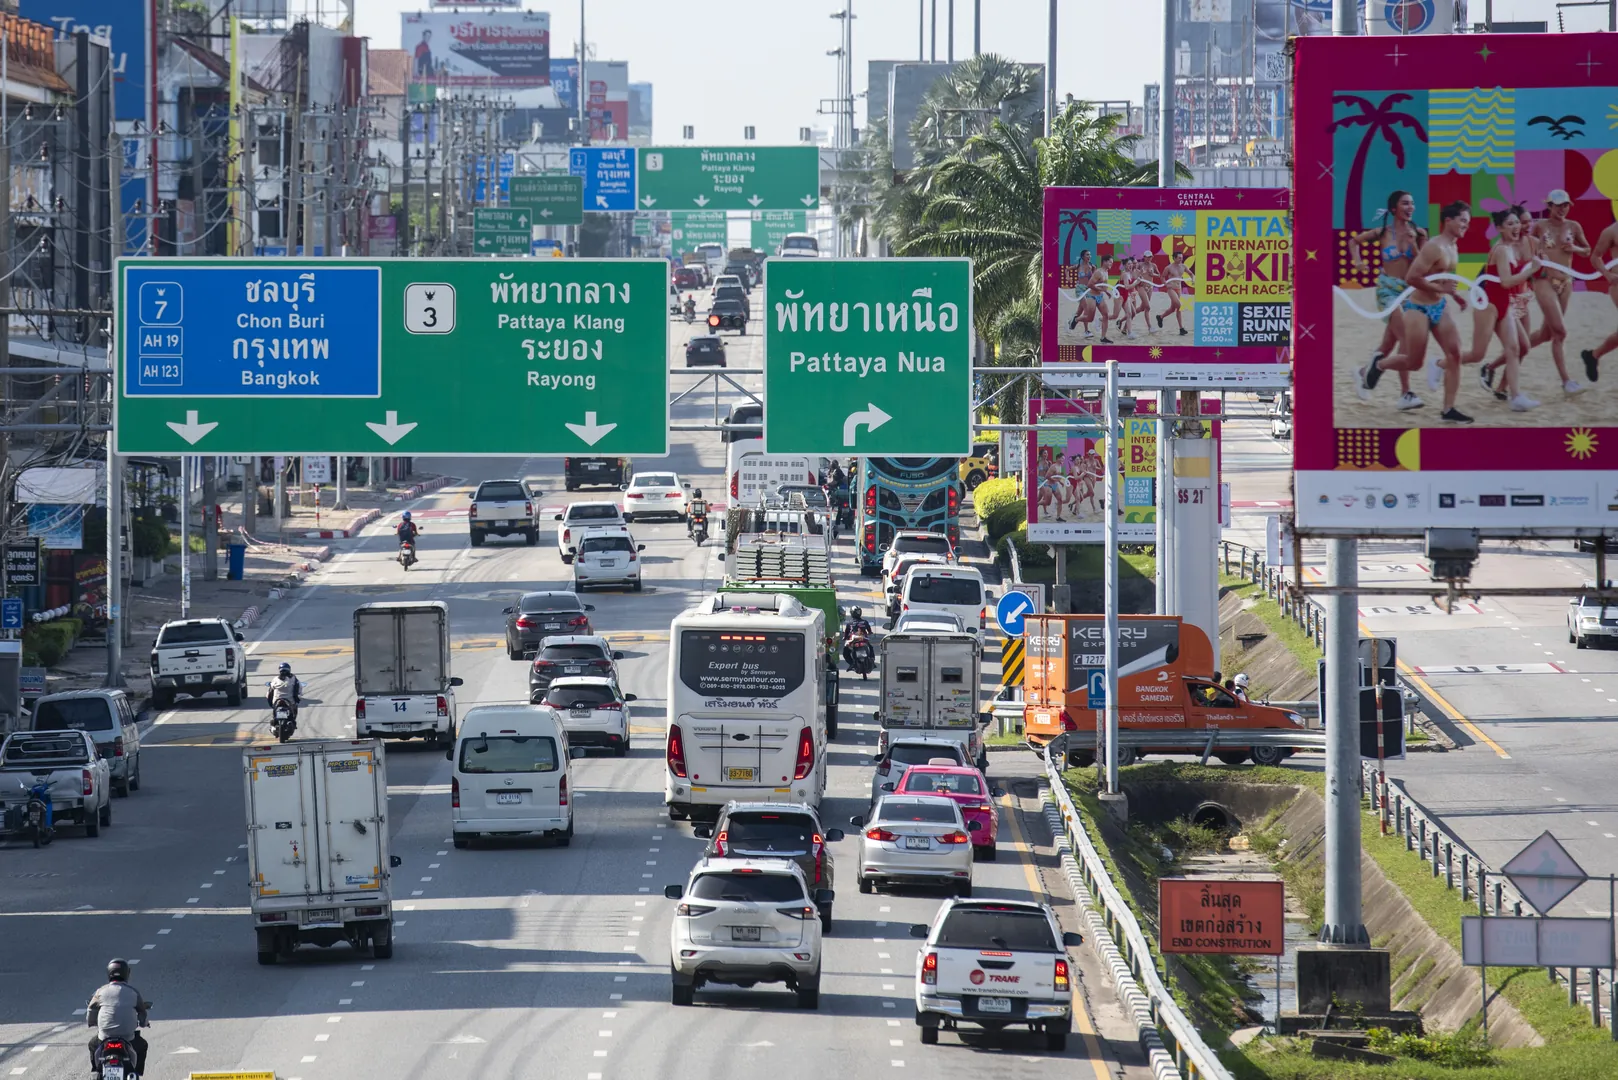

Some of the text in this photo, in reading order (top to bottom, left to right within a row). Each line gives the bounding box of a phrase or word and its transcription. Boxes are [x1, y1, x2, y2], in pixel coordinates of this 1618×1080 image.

[602, 150, 626, 161] ชลบุรี
[701, 149, 756, 162] พัทยากลาง
[702, 164, 755, 173] Pattaya Klang
[597, 169, 631, 181] กรุงเทพ
[713, 174, 745, 184] ระยอง
[714, 185, 743, 193] Rayong
[496, 235, 528, 248] กรุงเทพ
[246, 272, 316, 311] ชลบุรี
[490, 272, 631, 304] พัทยากลาง
[1206, 284, 1285, 295] BEACH RACE
[154, 301, 168, 320] 7
[775, 287, 959, 333] พัทยาเหนือ
[1201, 306, 1234, 316] 02.11
[236, 313, 325, 329] Chon Buri
[422, 307, 438, 328] 3
[498, 314, 625, 333] Pattaya Klang
[1201, 316, 1234, 327] 2024
[1201, 327, 1233, 335] START
[143, 335, 179, 348] AH 19
[1242, 333, 1279, 342] EVENT
[232, 338, 329, 368] กรุงเทพ
[521, 339, 604, 361] ระยอง
[790, 352, 946, 378] Pattaya Nua
[143, 365, 179, 378] AH 123
[241, 370, 320, 389] Bangkok
[527, 371, 597, 390] Rayong
[1128, 479, 1149, 487] 02.11
[1178, 489, 1203, 504] SS 21
[1072, 627, 1147, 639] KERY
[708, 662, 760, 670] Expert bus
[1086, 656, 1105, 665] 1217
[699, 676, 786, 684] www.sermyontour.com
[393, 702, 407, 712] 14
[1201, 884, 1242, 912] สิ้นสุด
[1181, 914, 1262, 934] เขตก่อสร้าง
[1172, 938, 1272, 949] END CONSTRUTION
[989, 974, 1021, 984] TRANE
[962, 987, 1029, 995] www.tranethailand.com
